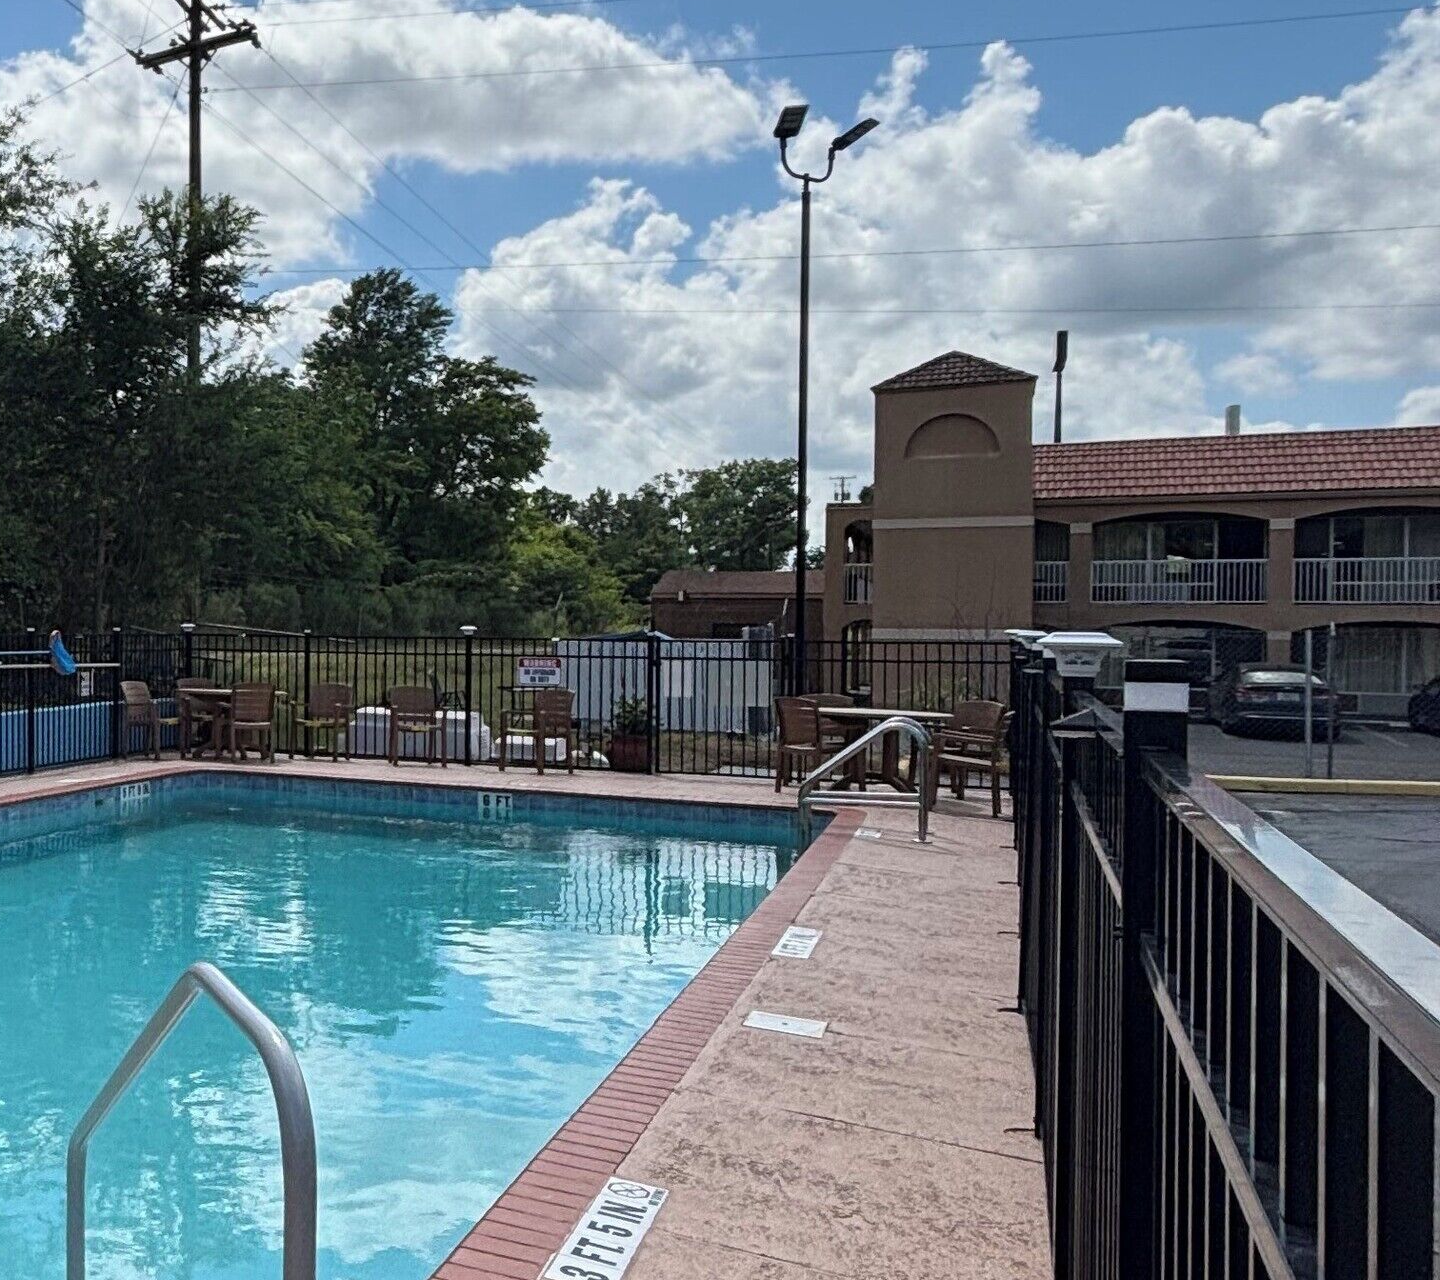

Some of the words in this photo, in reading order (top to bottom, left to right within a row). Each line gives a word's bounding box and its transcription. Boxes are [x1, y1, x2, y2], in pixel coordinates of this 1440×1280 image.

[597, 1200, 648, 1224] IN.
[586, 1220, 633, 1238] 5
[570, 1237, 625, 1266] FT.
